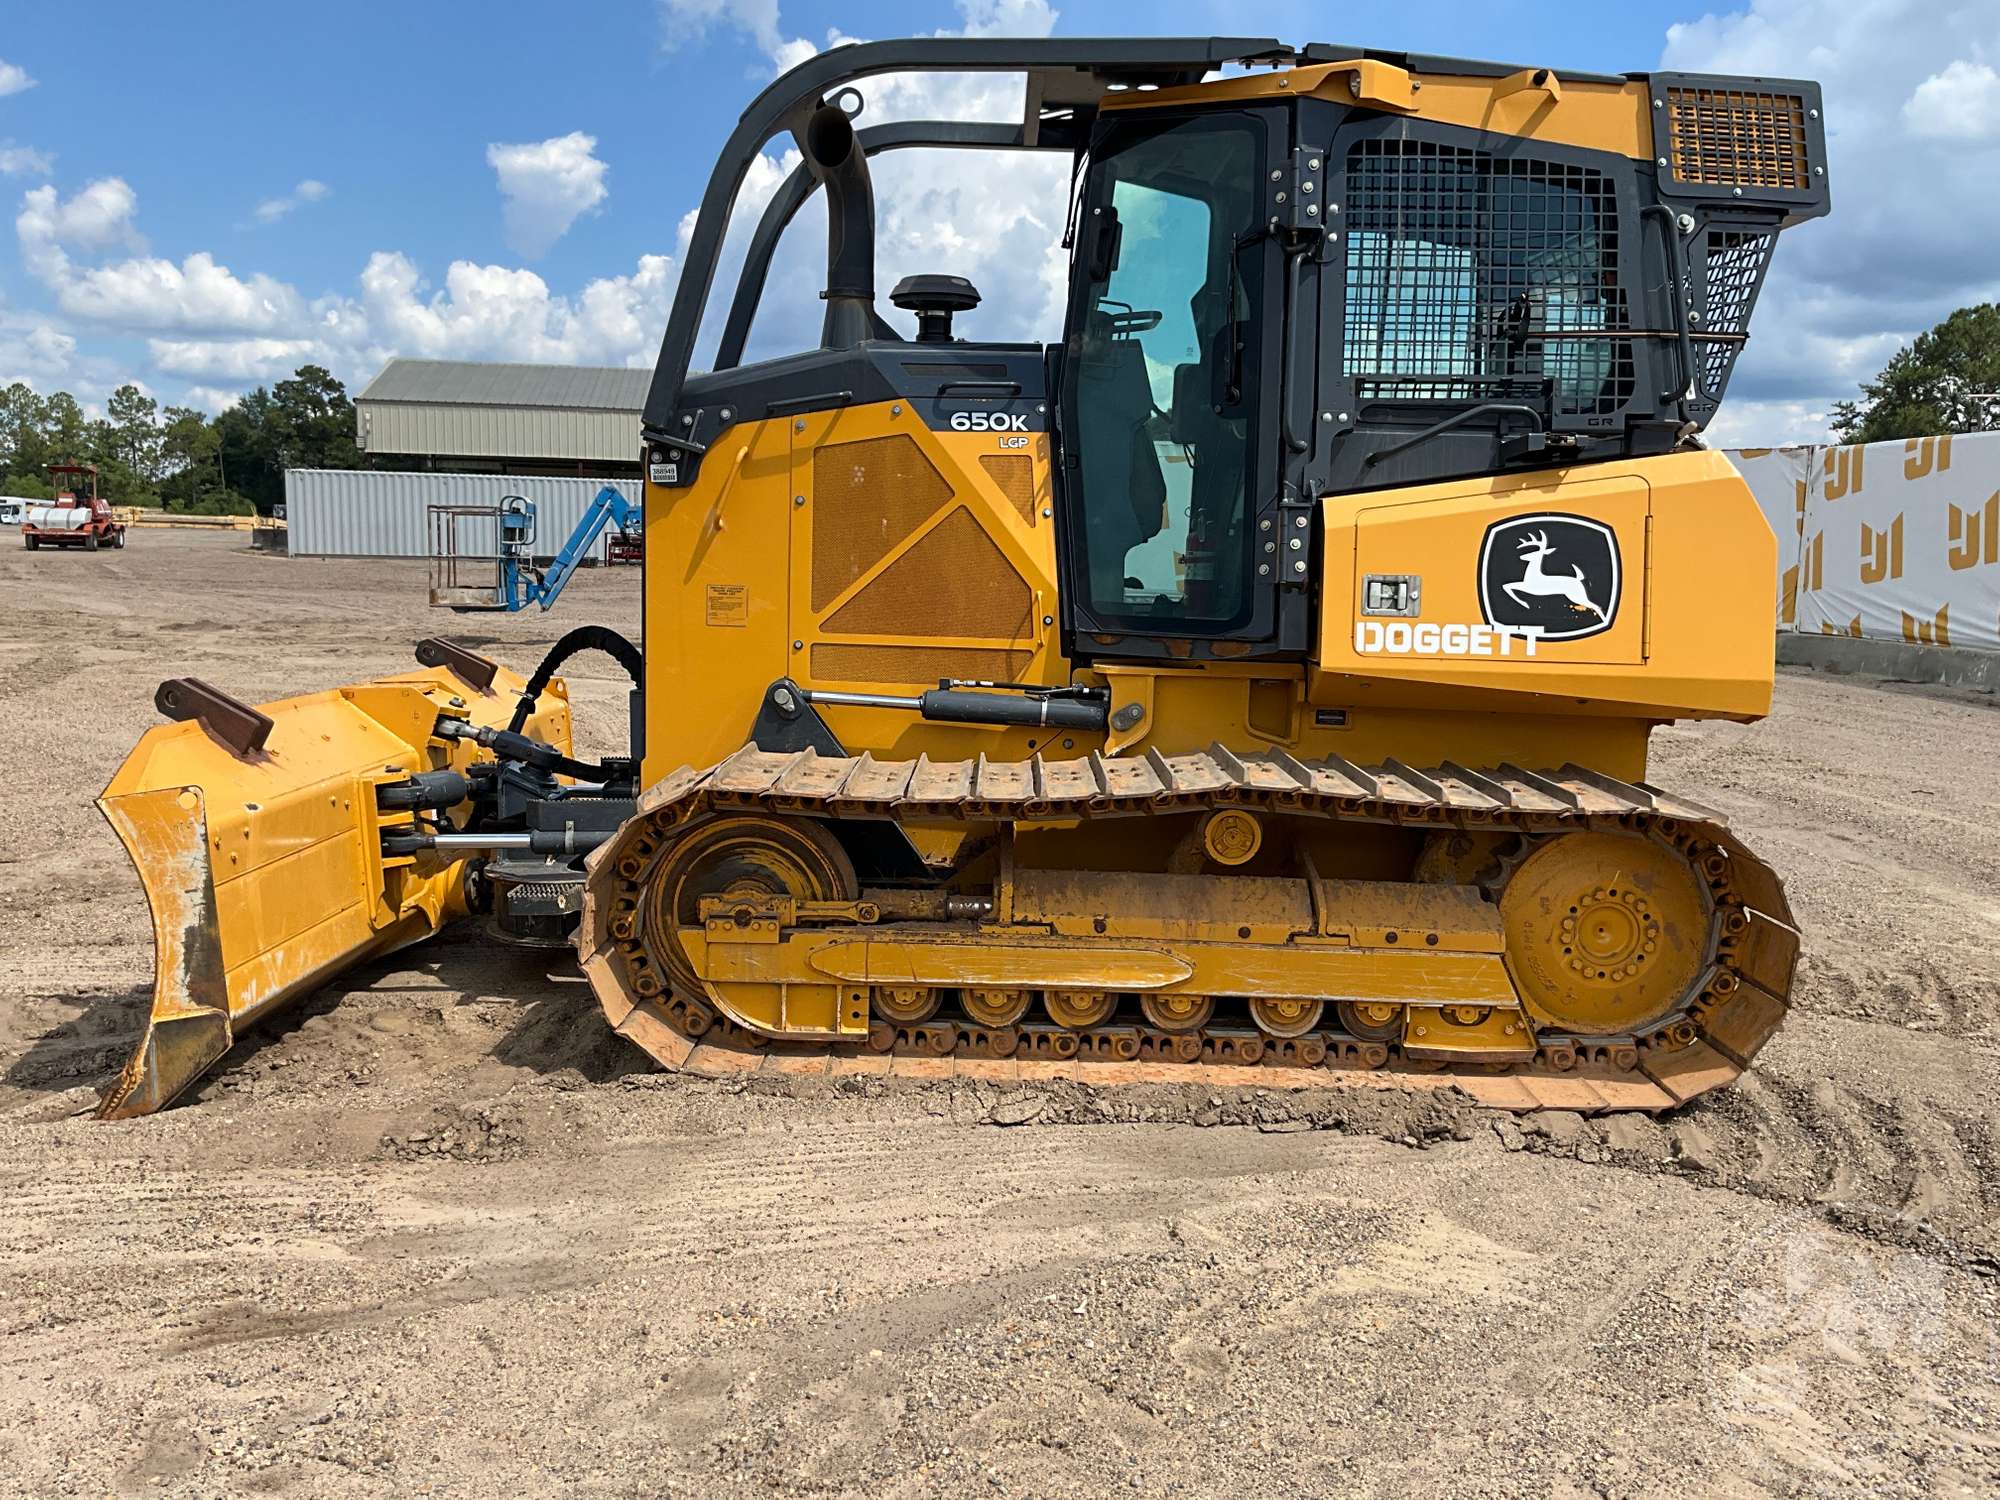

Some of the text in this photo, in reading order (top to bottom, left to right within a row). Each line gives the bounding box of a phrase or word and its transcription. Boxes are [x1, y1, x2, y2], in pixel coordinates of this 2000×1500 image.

[950, 411, 1029, 432] 650K
[1587, 417, 1614, 426] GR
[999, 436, 1029, 449] LGP
[1355, 622, 1545, 657] DOGGETT
